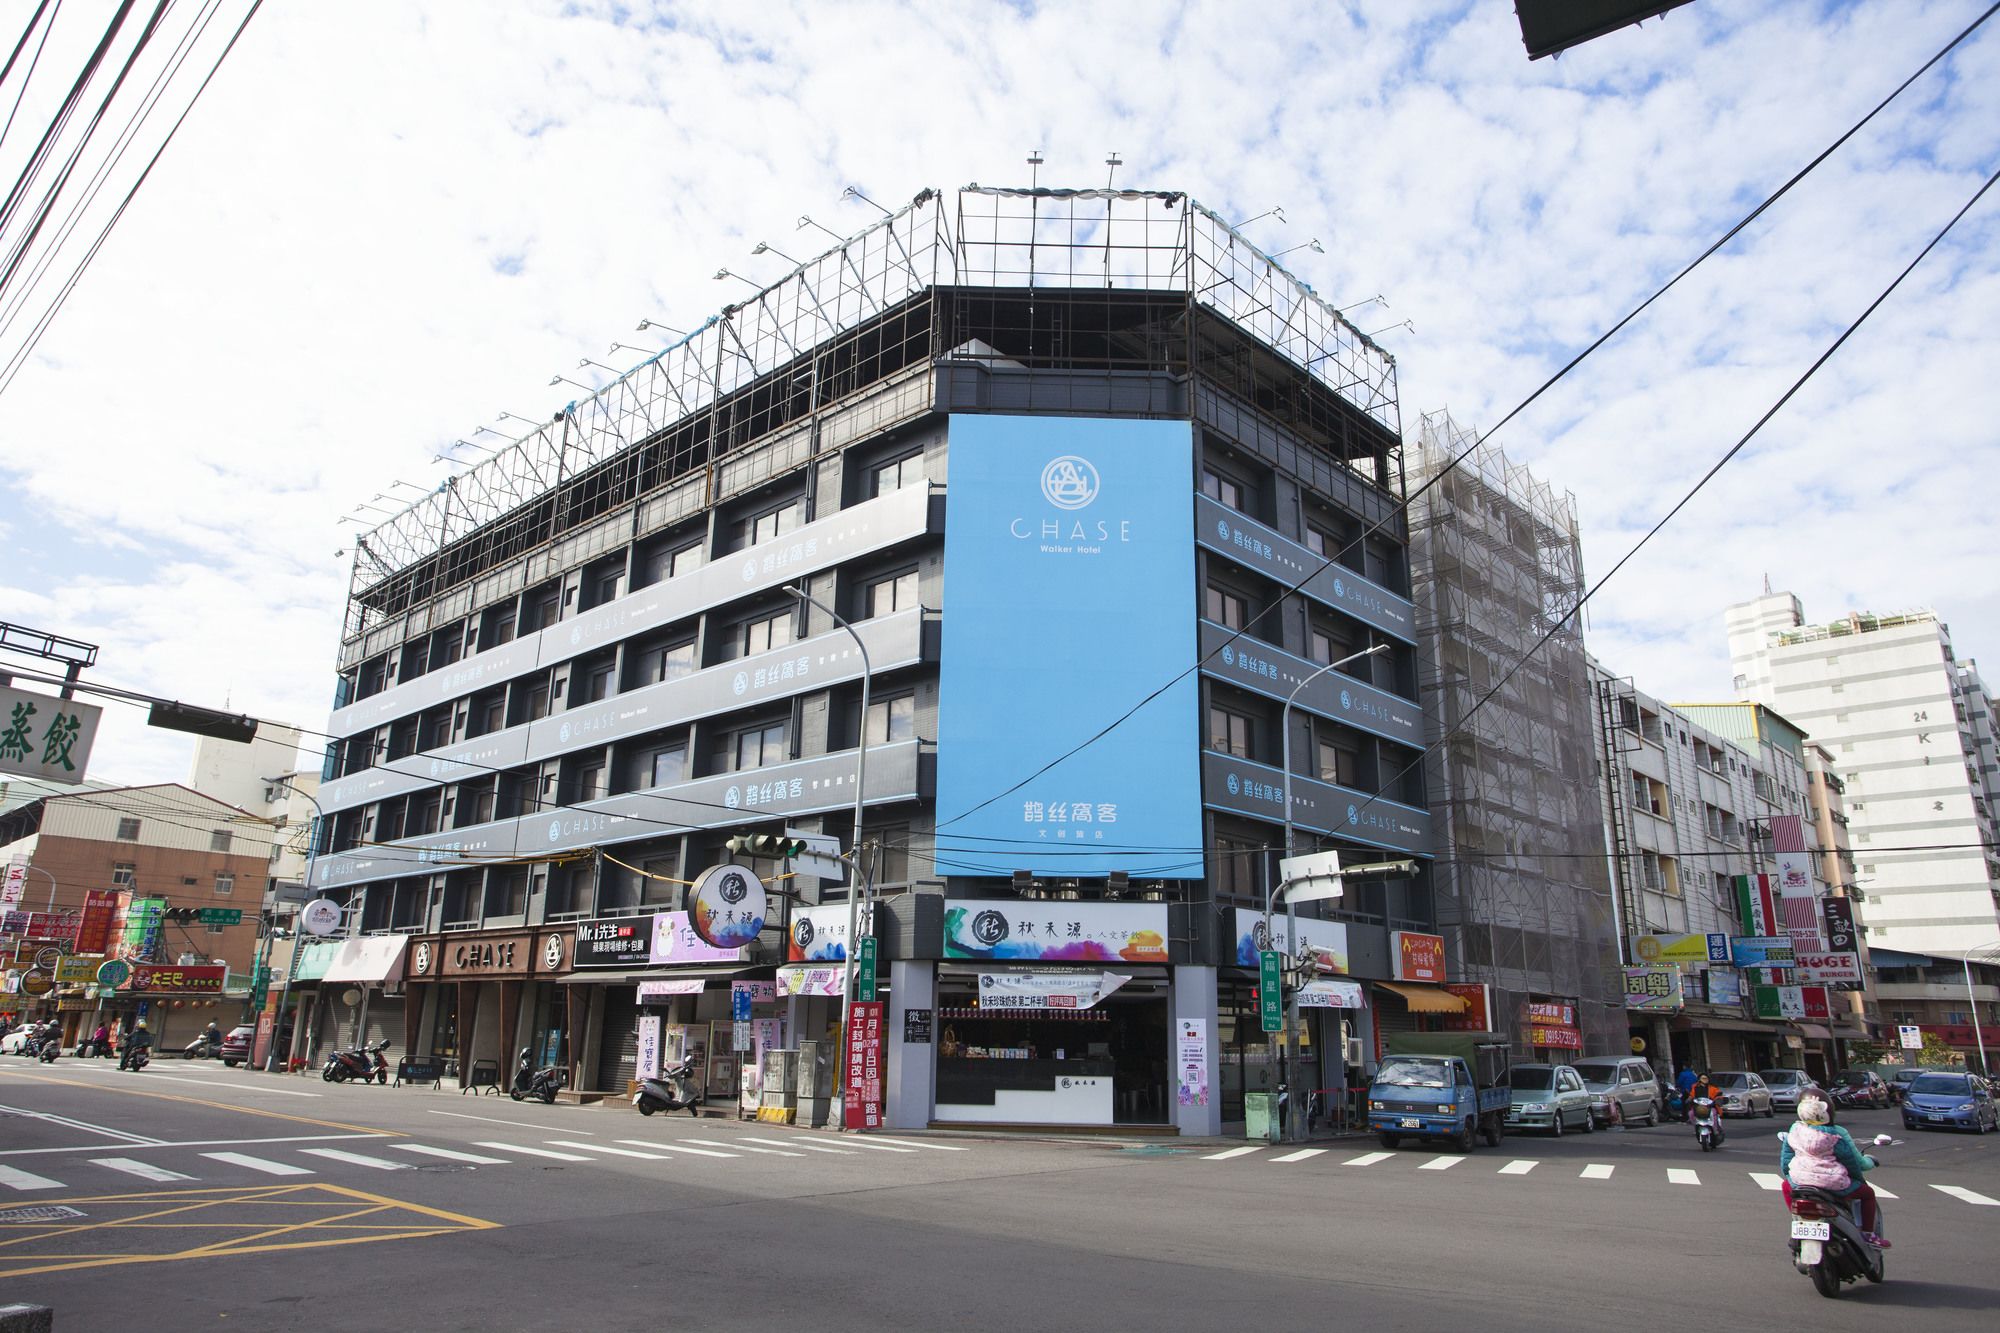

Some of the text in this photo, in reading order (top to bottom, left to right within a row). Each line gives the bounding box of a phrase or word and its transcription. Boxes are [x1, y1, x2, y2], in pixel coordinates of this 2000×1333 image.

[1010, 518, 1130, 541] CHASE
[1040, 545, 1101, 554] Walker Hotel
[455, 942, 515, 970] CHASE
[151, 971, 184, 986] 大三巴
[1264, 960, 1277, 1012] 福星路
